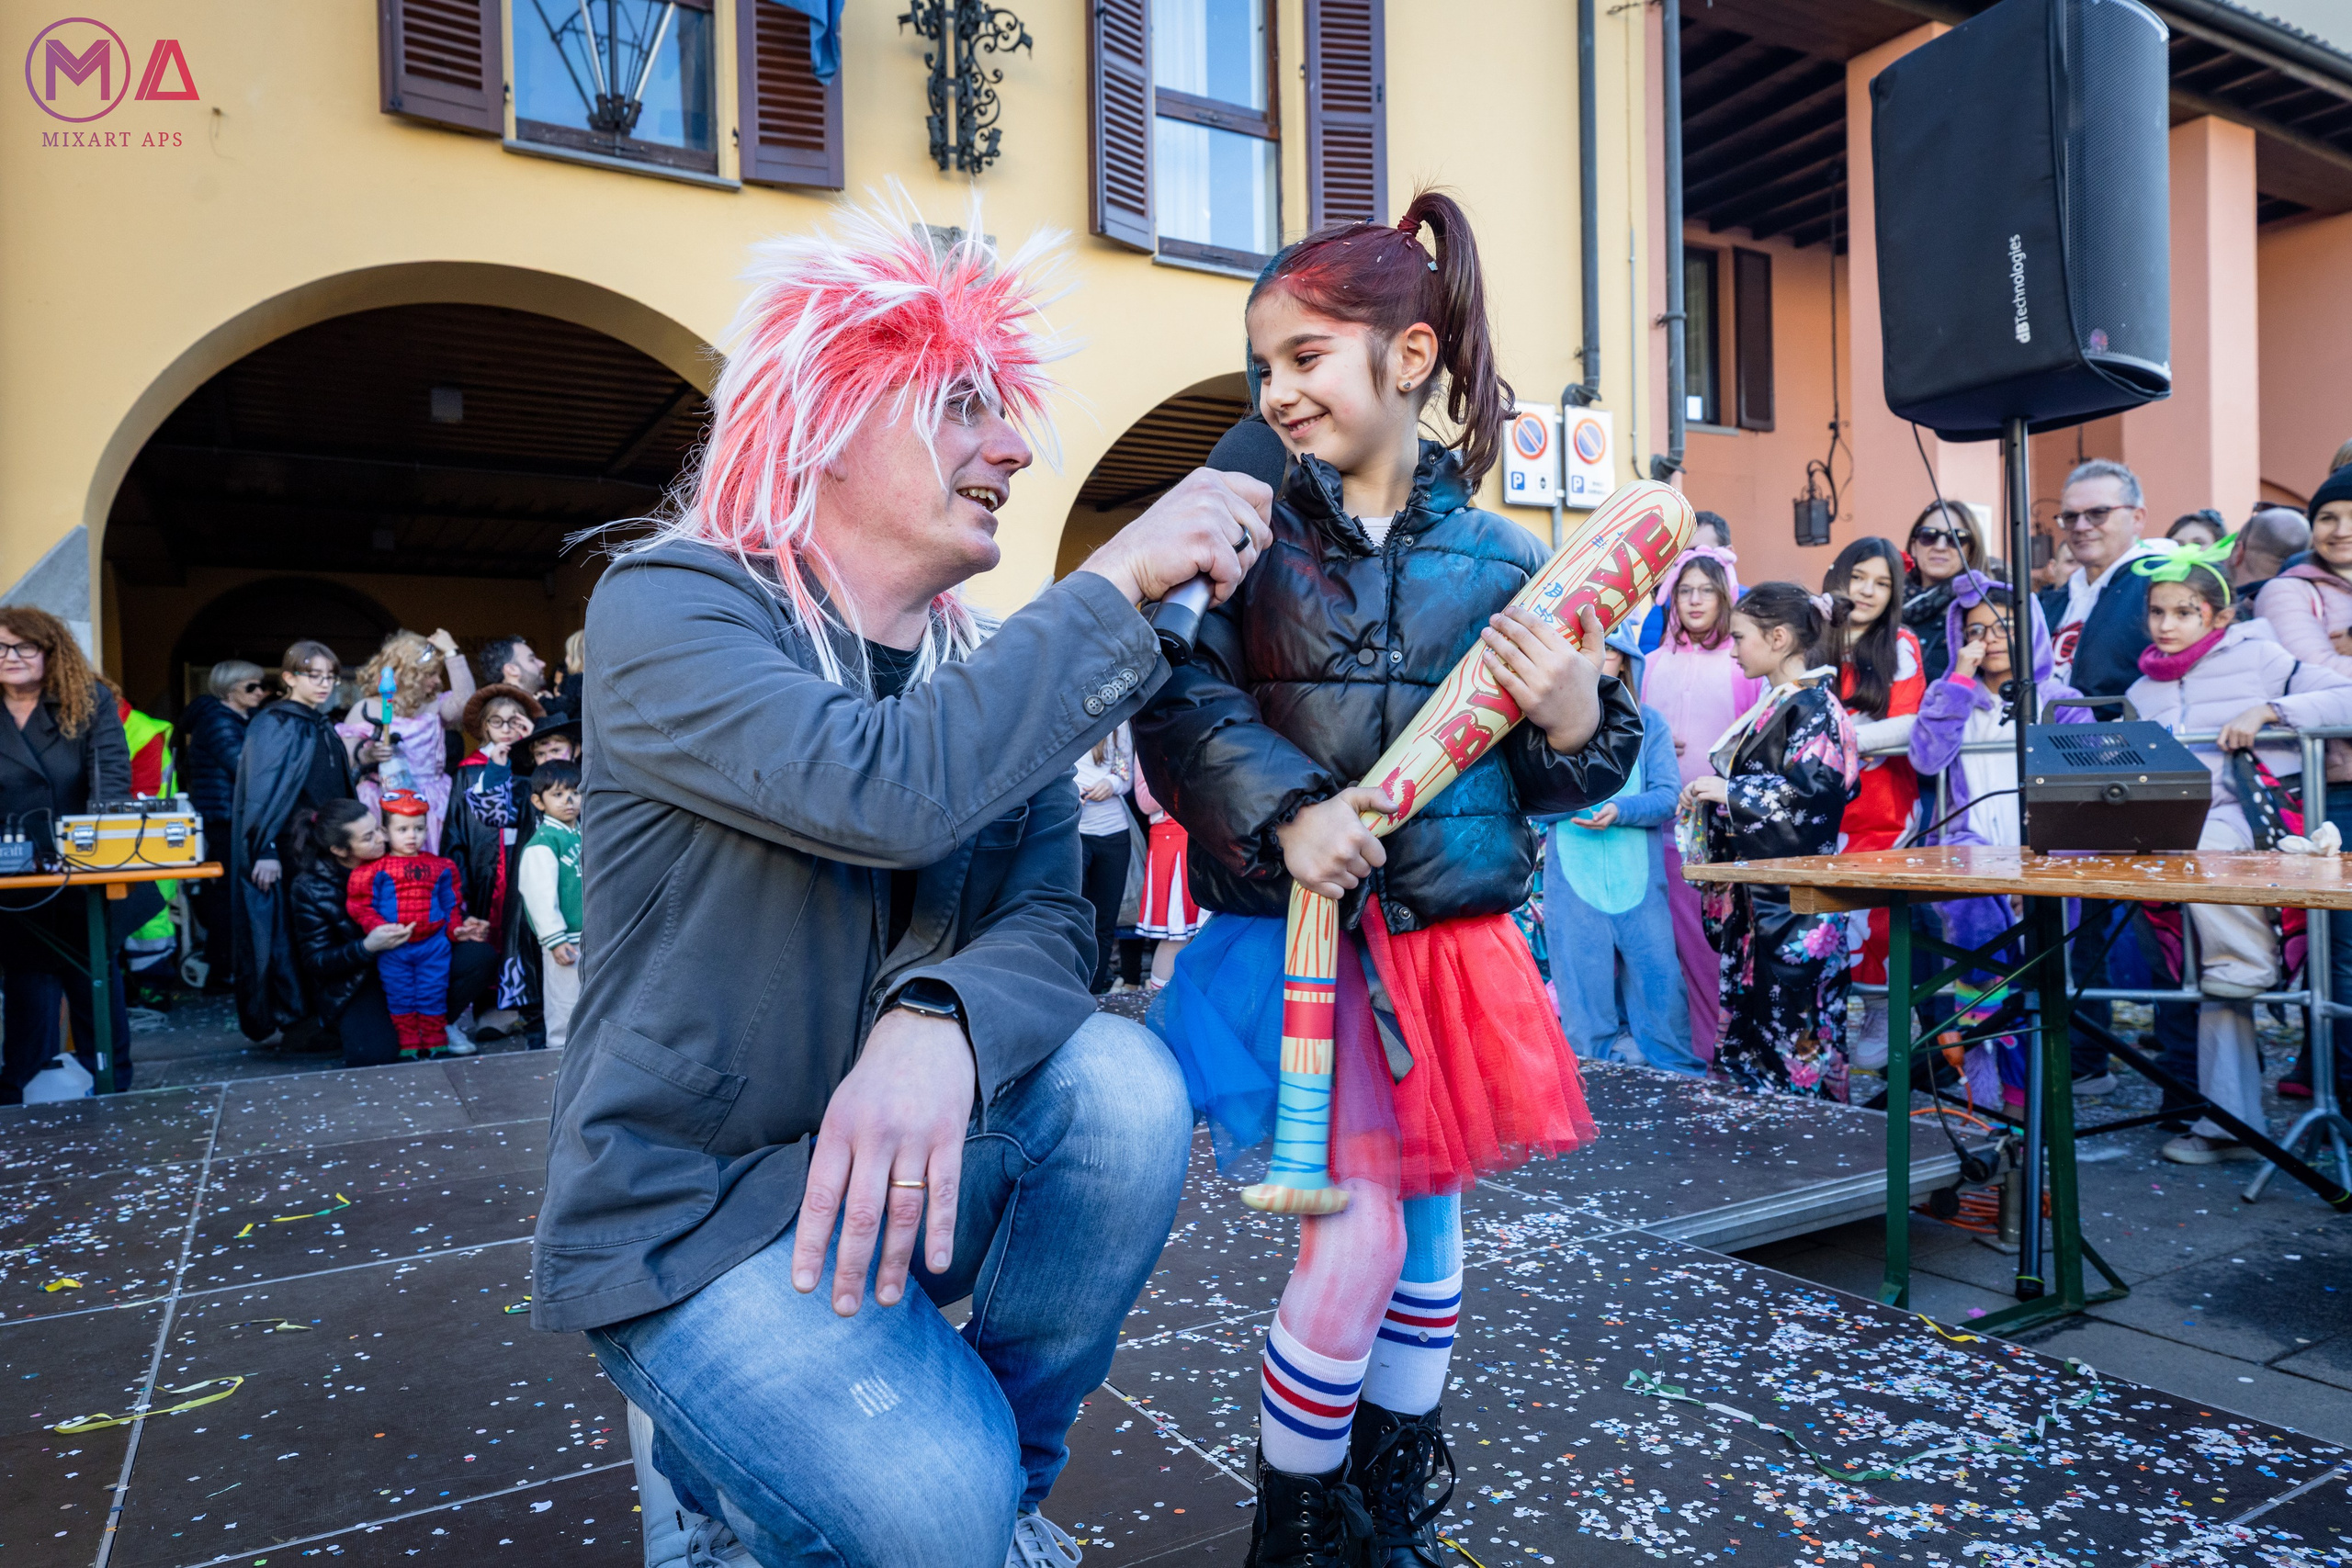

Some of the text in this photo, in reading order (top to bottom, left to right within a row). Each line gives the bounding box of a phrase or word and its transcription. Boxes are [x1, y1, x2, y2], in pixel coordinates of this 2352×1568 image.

[2007, 233, 2031, 344] dBTechnologies
[1430, 510, 1679, 774] BY BYE
